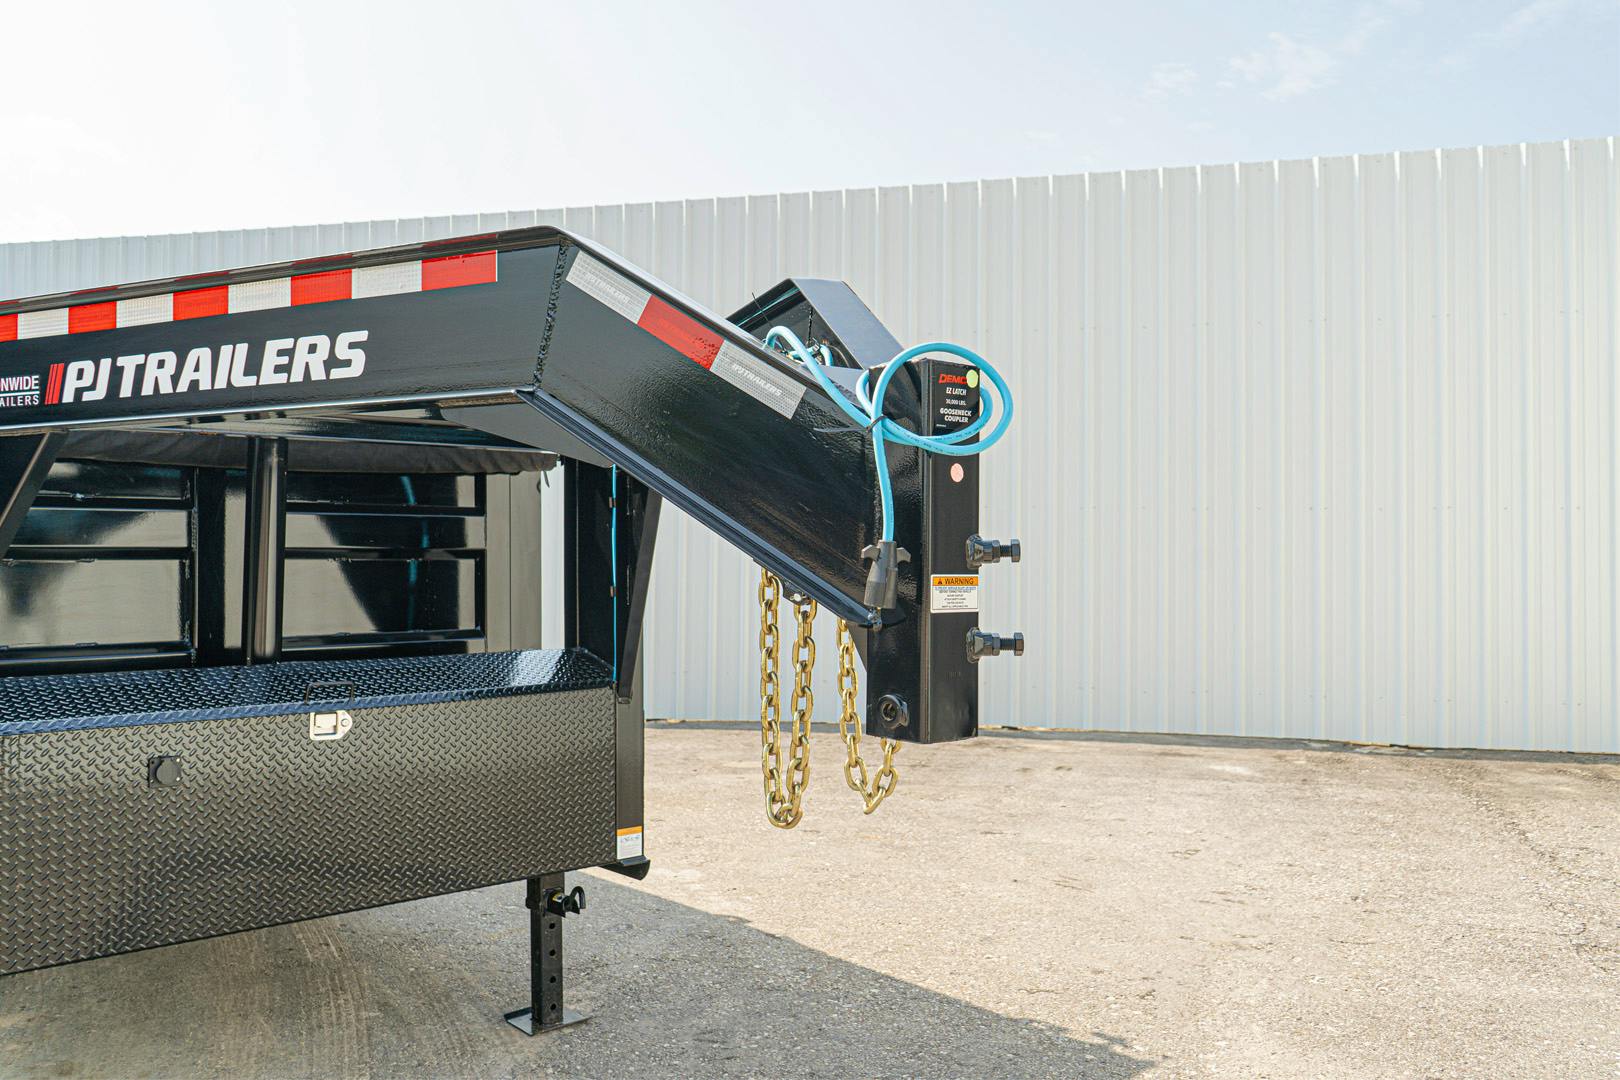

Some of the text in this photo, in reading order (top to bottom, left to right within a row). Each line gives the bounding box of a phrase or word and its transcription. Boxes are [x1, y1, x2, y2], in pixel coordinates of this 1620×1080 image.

[62, 330, 369, 404] PJ TRAILERS
[939, 374, 968, 385] DEMC
[953, 388, 966, 396] LATCH
[940, 407, 972, 417] GOOSENECK
[944, 415, 969, 423] COUPLER
[945, 577, 974, 585] WARNING
